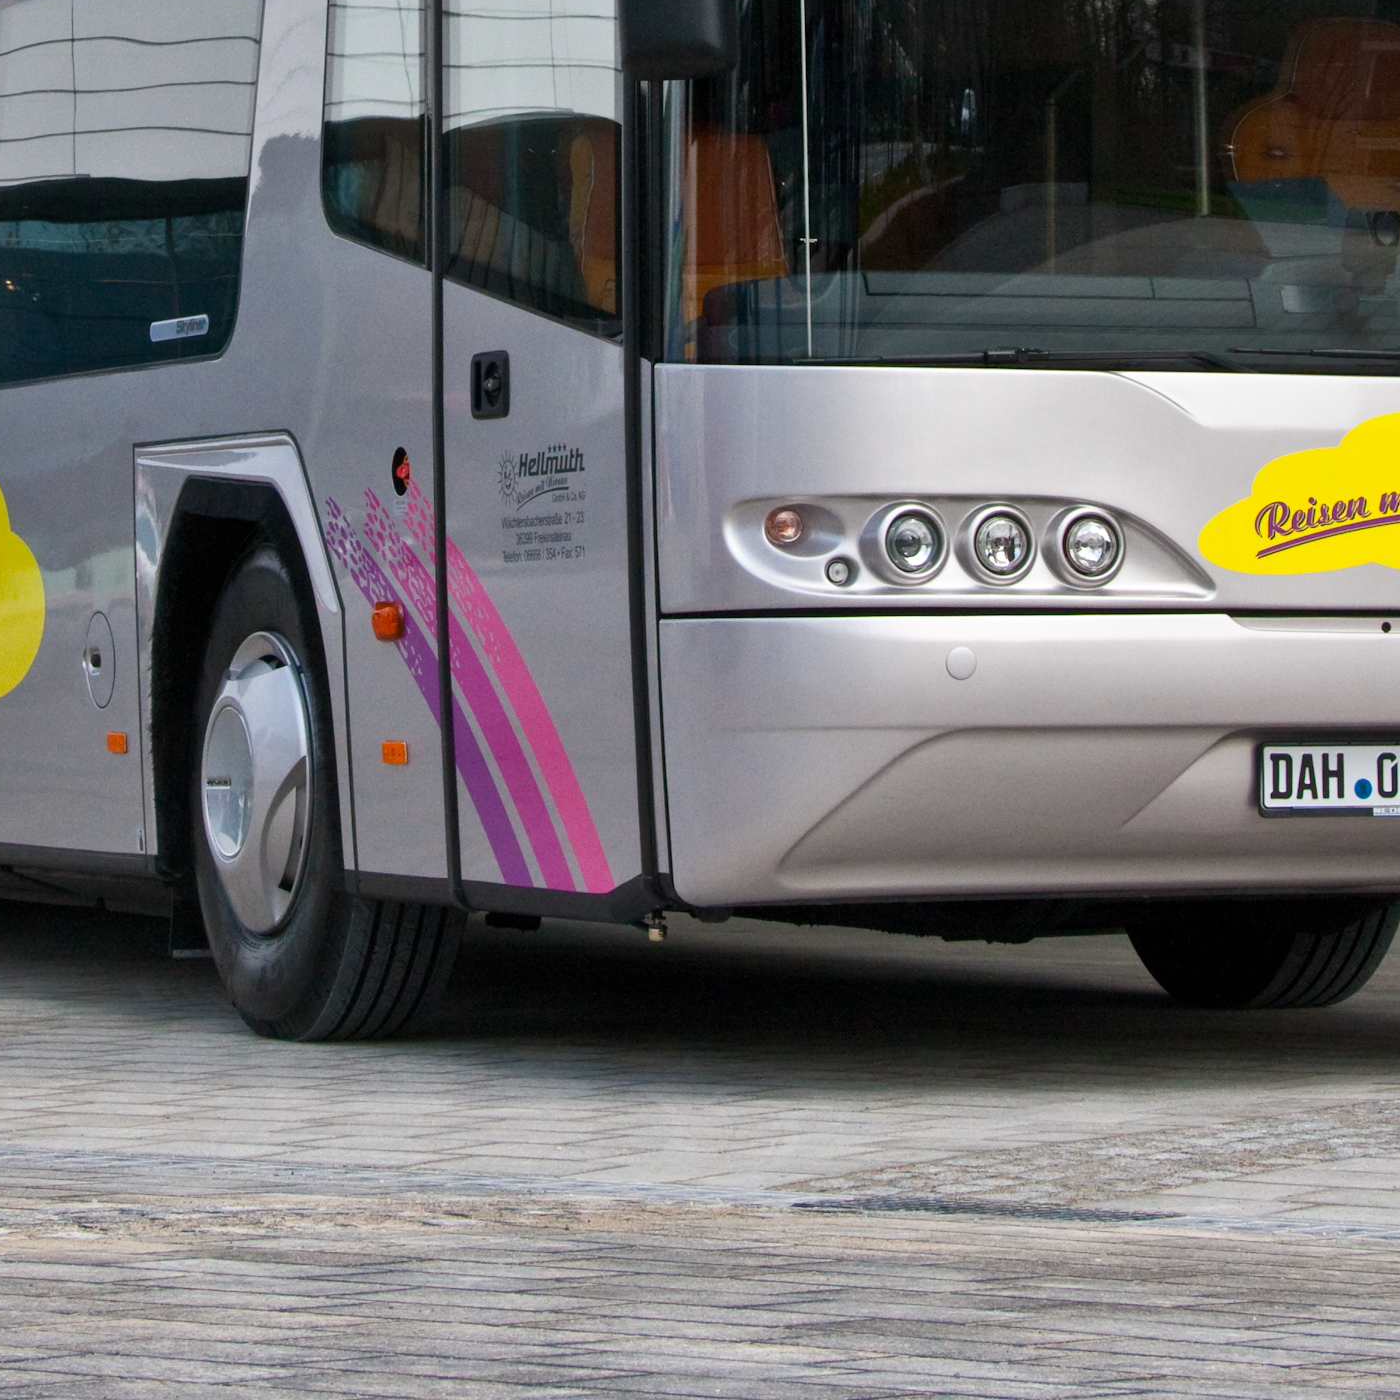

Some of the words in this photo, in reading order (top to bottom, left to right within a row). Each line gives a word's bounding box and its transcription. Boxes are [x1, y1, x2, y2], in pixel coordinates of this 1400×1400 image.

[518, 447, 585, 477] Hellmuth
[552, 493, 566, 503] GmbH
[578, 490, 586, 501] KG
[564, 511, 572, 525] 21
[576, 510, 585, 523] 23
[1254, 496, 1370, 540] Reisen
[533, 529, 572, 543] Freiensteinau
[574, 545, 586, 559] 571
[1269, 752, 1345, 800] DAH
